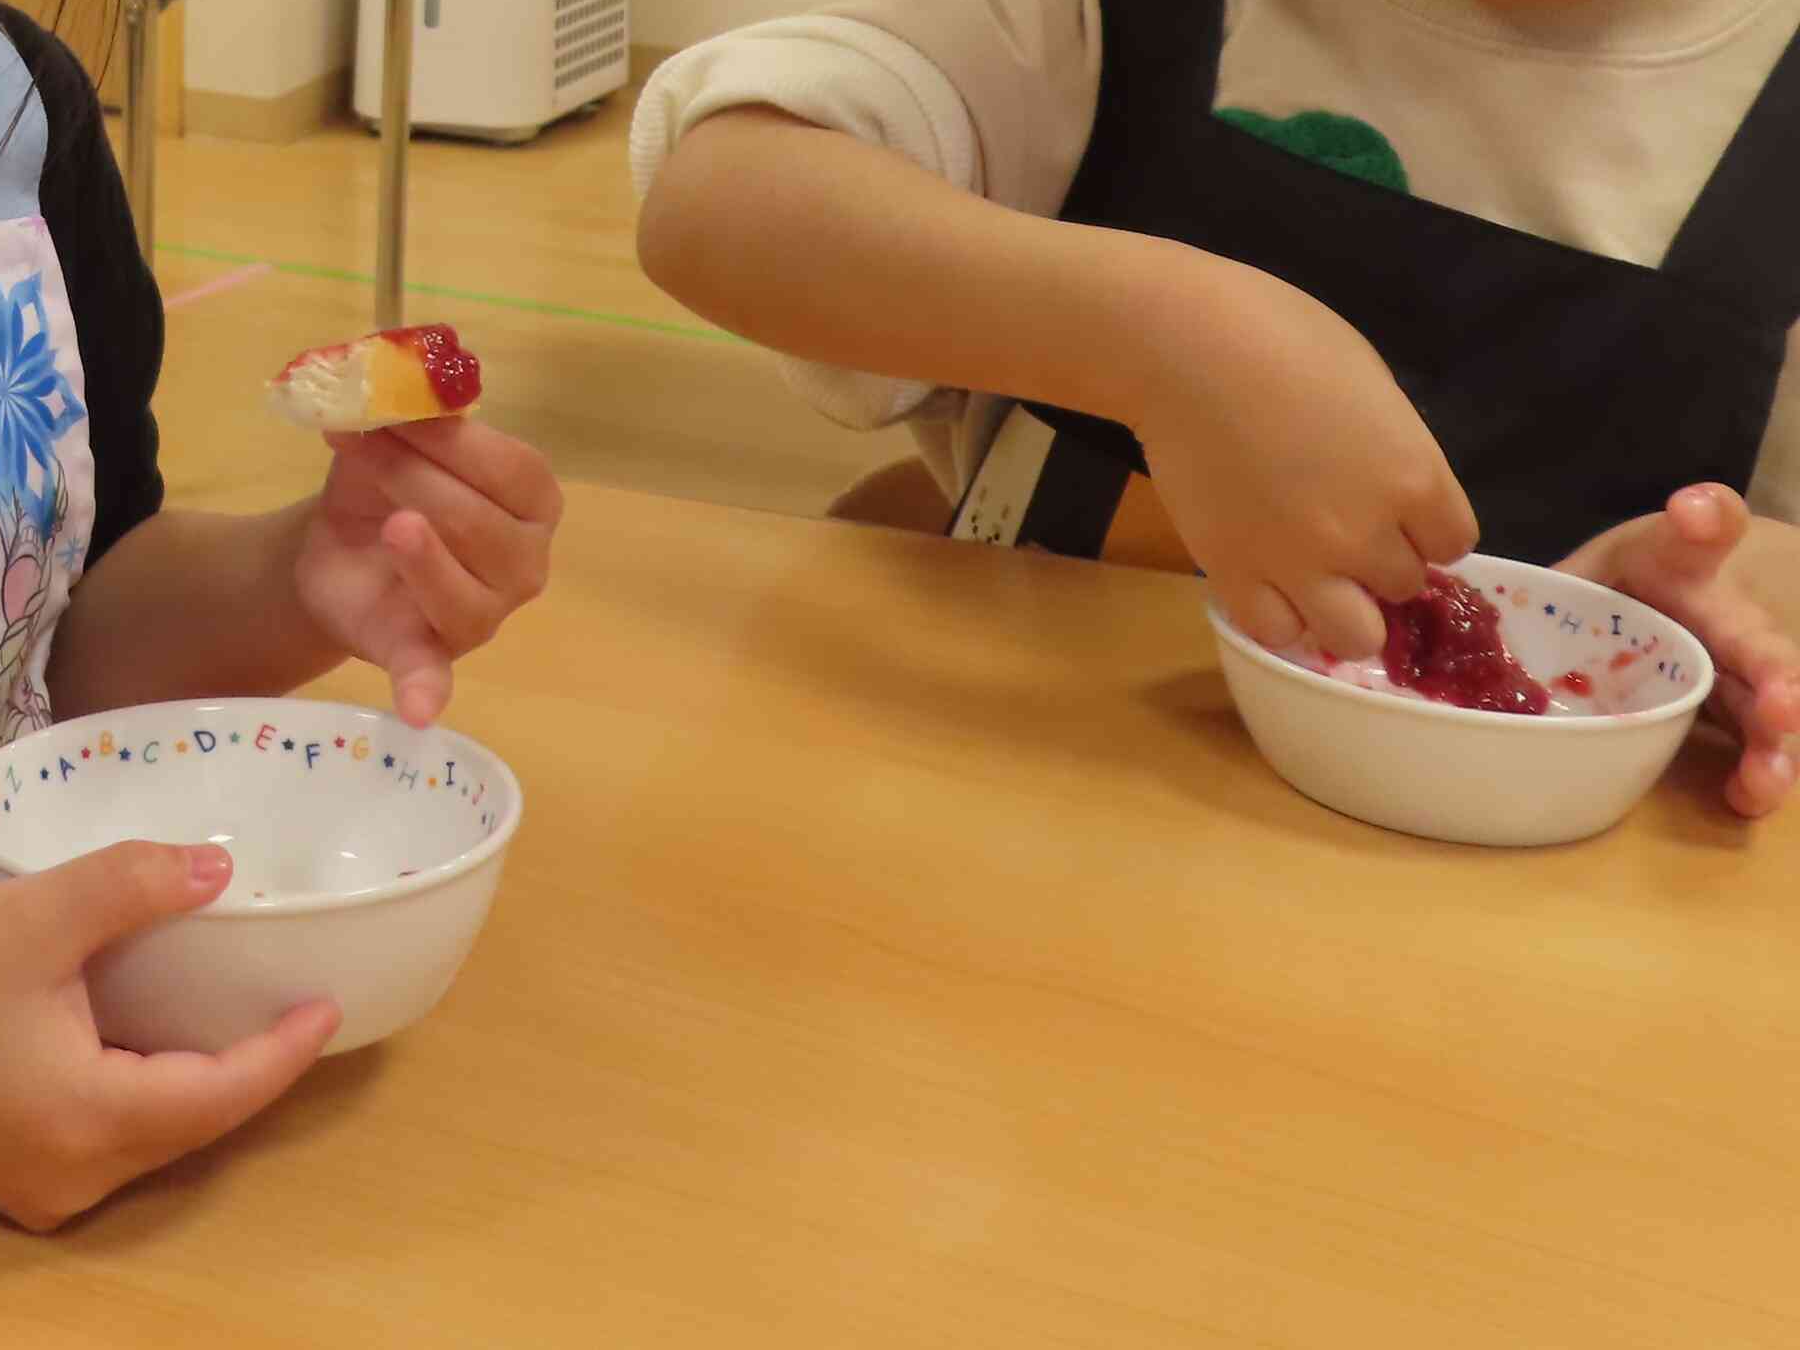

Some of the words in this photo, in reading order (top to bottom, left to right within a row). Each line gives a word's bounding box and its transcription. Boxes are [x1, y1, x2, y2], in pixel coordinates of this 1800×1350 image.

[58, 756, 77, 783] A
[98, 731, 115, 757] B
[142, 740, 161, 765] C
[192, 729, 217, 754] D
[254, 723, 278, 752] E
[304, 742, 321, 770] F
[351, 734, 370, 762] G
[397, 761, 421, 791] H
[445, 760, 456, 787] I
